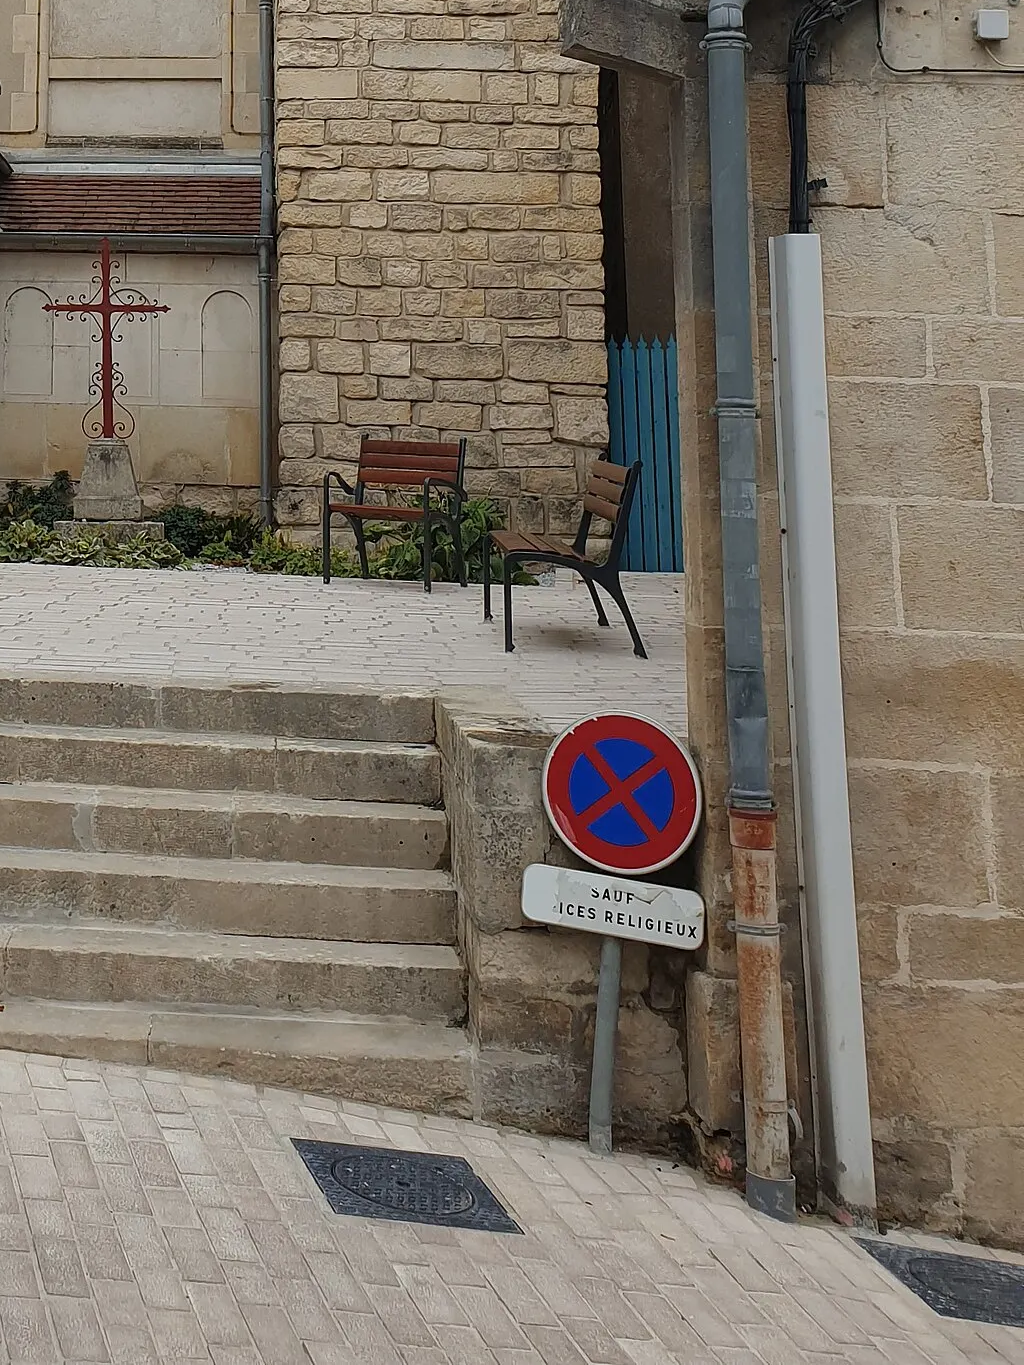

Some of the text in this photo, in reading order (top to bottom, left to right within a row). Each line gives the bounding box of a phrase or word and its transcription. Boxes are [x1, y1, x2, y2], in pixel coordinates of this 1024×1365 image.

[591, 888, 635, 905] SAUF
[553, 901, 697, 939] ICES RELIGIEUX
